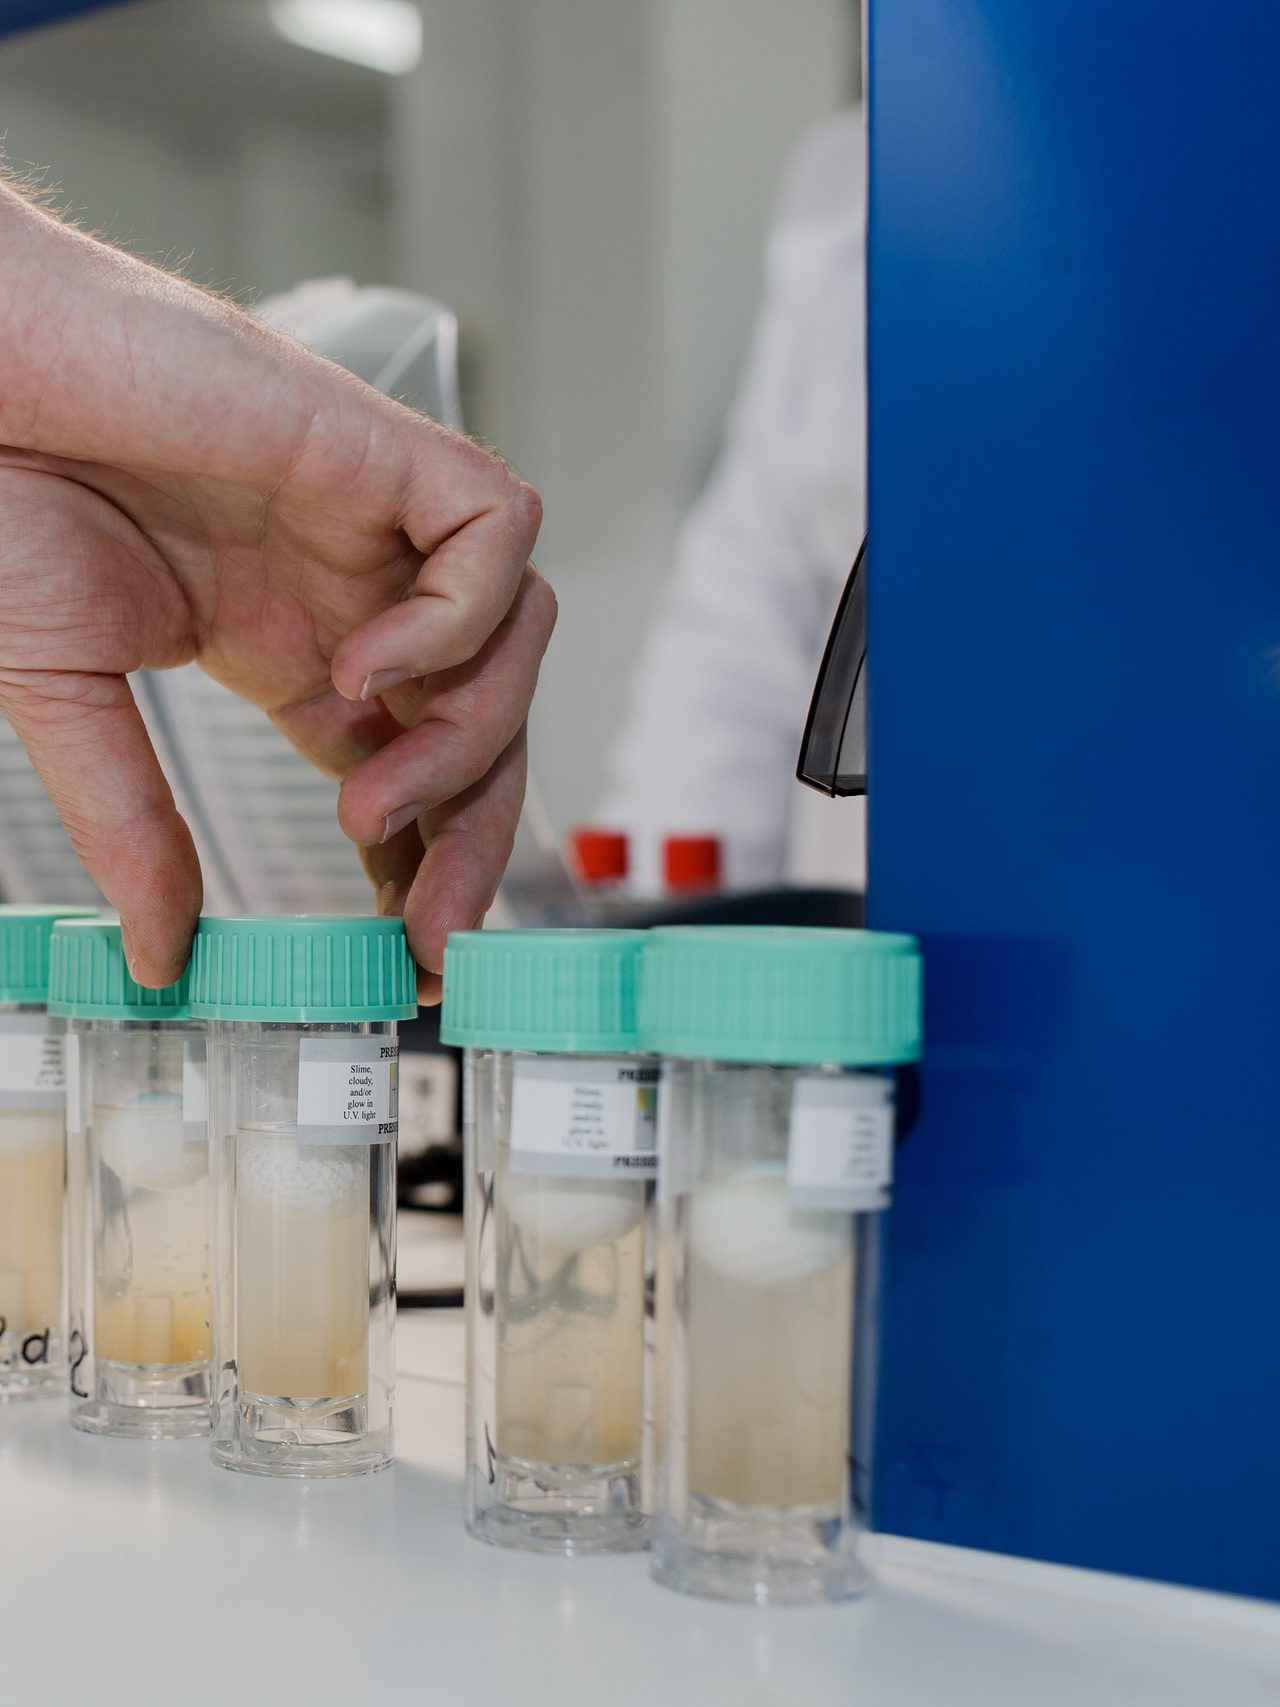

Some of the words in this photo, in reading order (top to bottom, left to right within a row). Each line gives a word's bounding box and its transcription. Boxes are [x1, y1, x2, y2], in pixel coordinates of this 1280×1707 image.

[350, 1065, 373, 1074] Slime,
[348, 1076, 374, 1087] cloudy,
[350, 1088, 372, 1097] and/or
[347, 1100, 365, 1111] glow
[366, 1099, 373, 1108] in
[343, 1111, 359, 1120] U.V.
[361, 1111, 376, 1122] light
